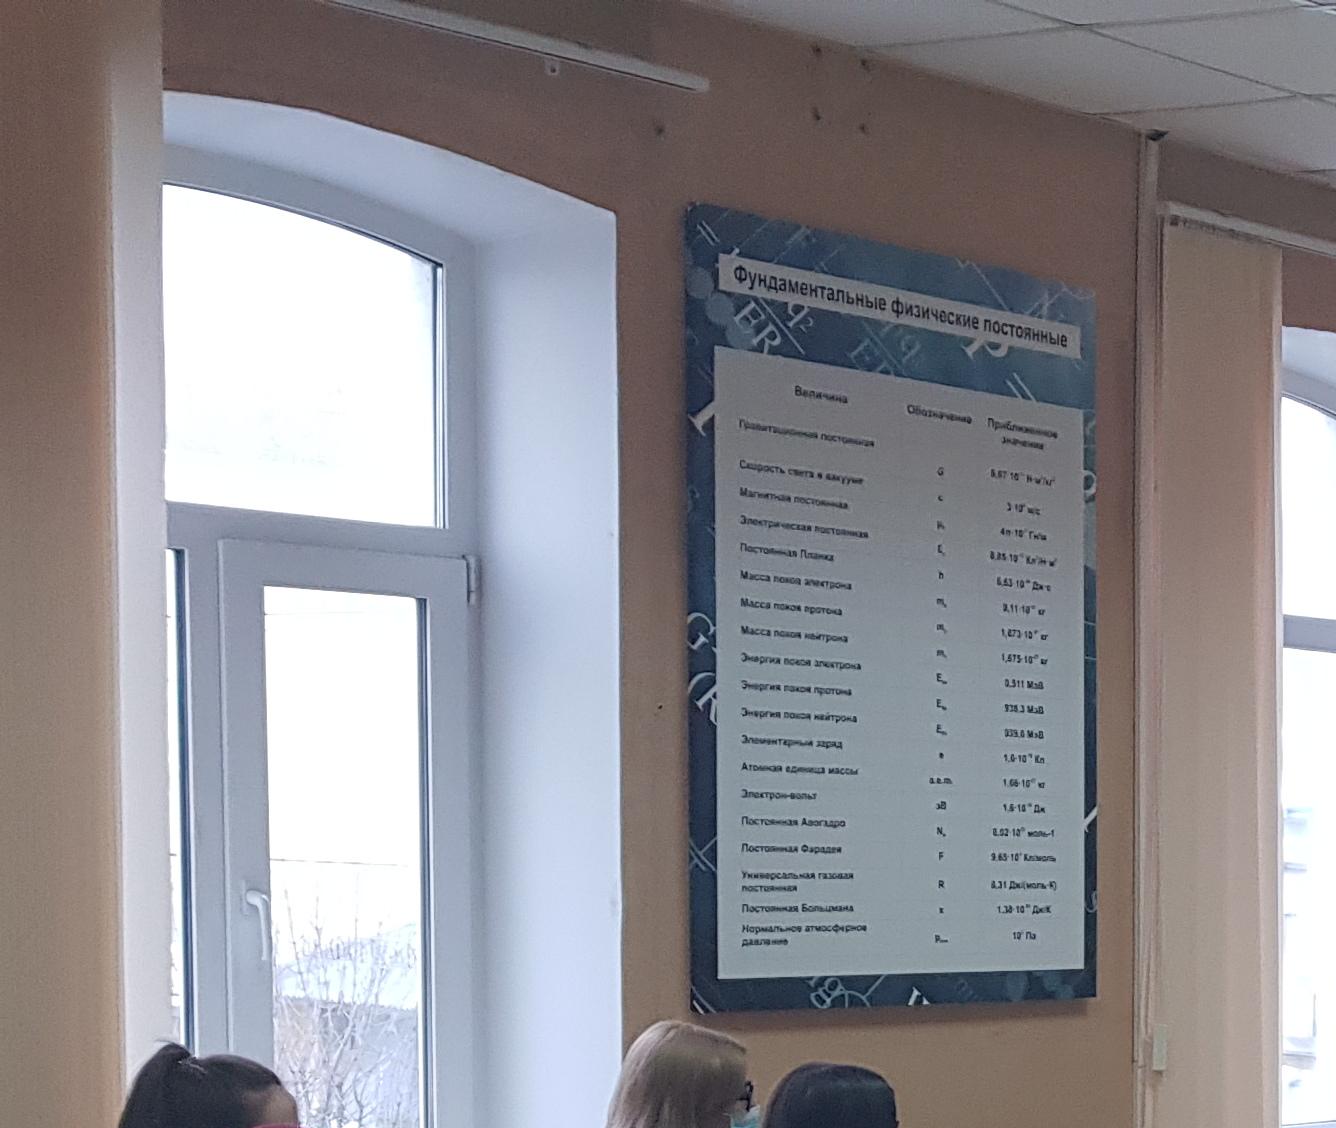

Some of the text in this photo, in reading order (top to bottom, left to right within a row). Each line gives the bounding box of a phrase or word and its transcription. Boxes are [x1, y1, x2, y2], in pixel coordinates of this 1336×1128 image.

[733, 264, 1069, 348] Фундаментальные физические постоянные
[795, 385, 848, 404] Величина
[740, 460, 786, 474] Скорость
[740, 487, 848, 509] Магнитная постоянная
[740, 514, 869, 539] Электрическая постоянная
[741, 542, 834, 561] Постоянная Планка
[741, 570, 852, 590] Масса покоя электрона
[741, 598, 843, 616] Масса покоя протона
[741, 625, 848, 644] Масса покоя нейтрона
[741, 652, 861, 671] Энергия покоя электрона
[741, 680, 852, 698] Энергия покоя протона
[741, 707, 857, 724] Энергия покоя нейтрона
[741, 762, 782, 773] Атомная
[828, 766, 859, 776] массы
[741, 788, 818, 801] Электрон-вольт
[741, 816, 846, 829] Постоянная Авогадро
[741, 843, 842, 855] Постоянная Фарадея
[741, 870, 854, 881] Универсальная газовая
[741, 885, 797, 893] постоянная
[741, 903, 798, 913] Постоянная
[741, 923, 867, 935] Нормальное атмосферное
